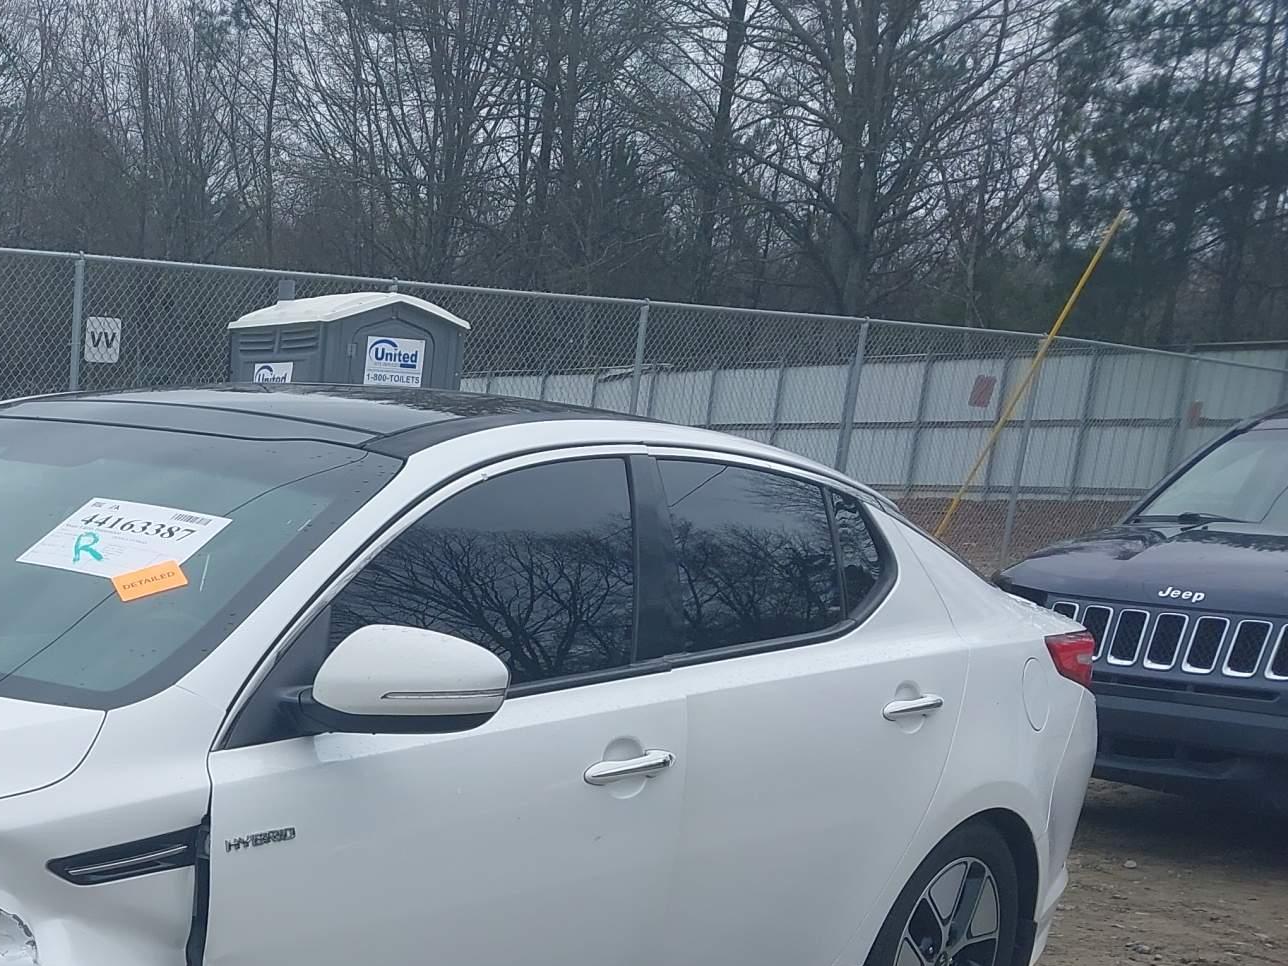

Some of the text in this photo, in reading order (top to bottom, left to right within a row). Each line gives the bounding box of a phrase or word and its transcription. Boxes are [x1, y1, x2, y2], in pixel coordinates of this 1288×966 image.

[90, 330, 117, 349] VV
[374, 347, 418, 364] United
[366, 373, 420, 385] 1-800-TOILETS
[81, 512, 198, 543] 44163387
[71, 530, 104, 564] R
[122, 570, 176, 591] DETAILED
[1158, 586, 1206, 604] Jeep
[224, 826, 296, 853] HYBRID
